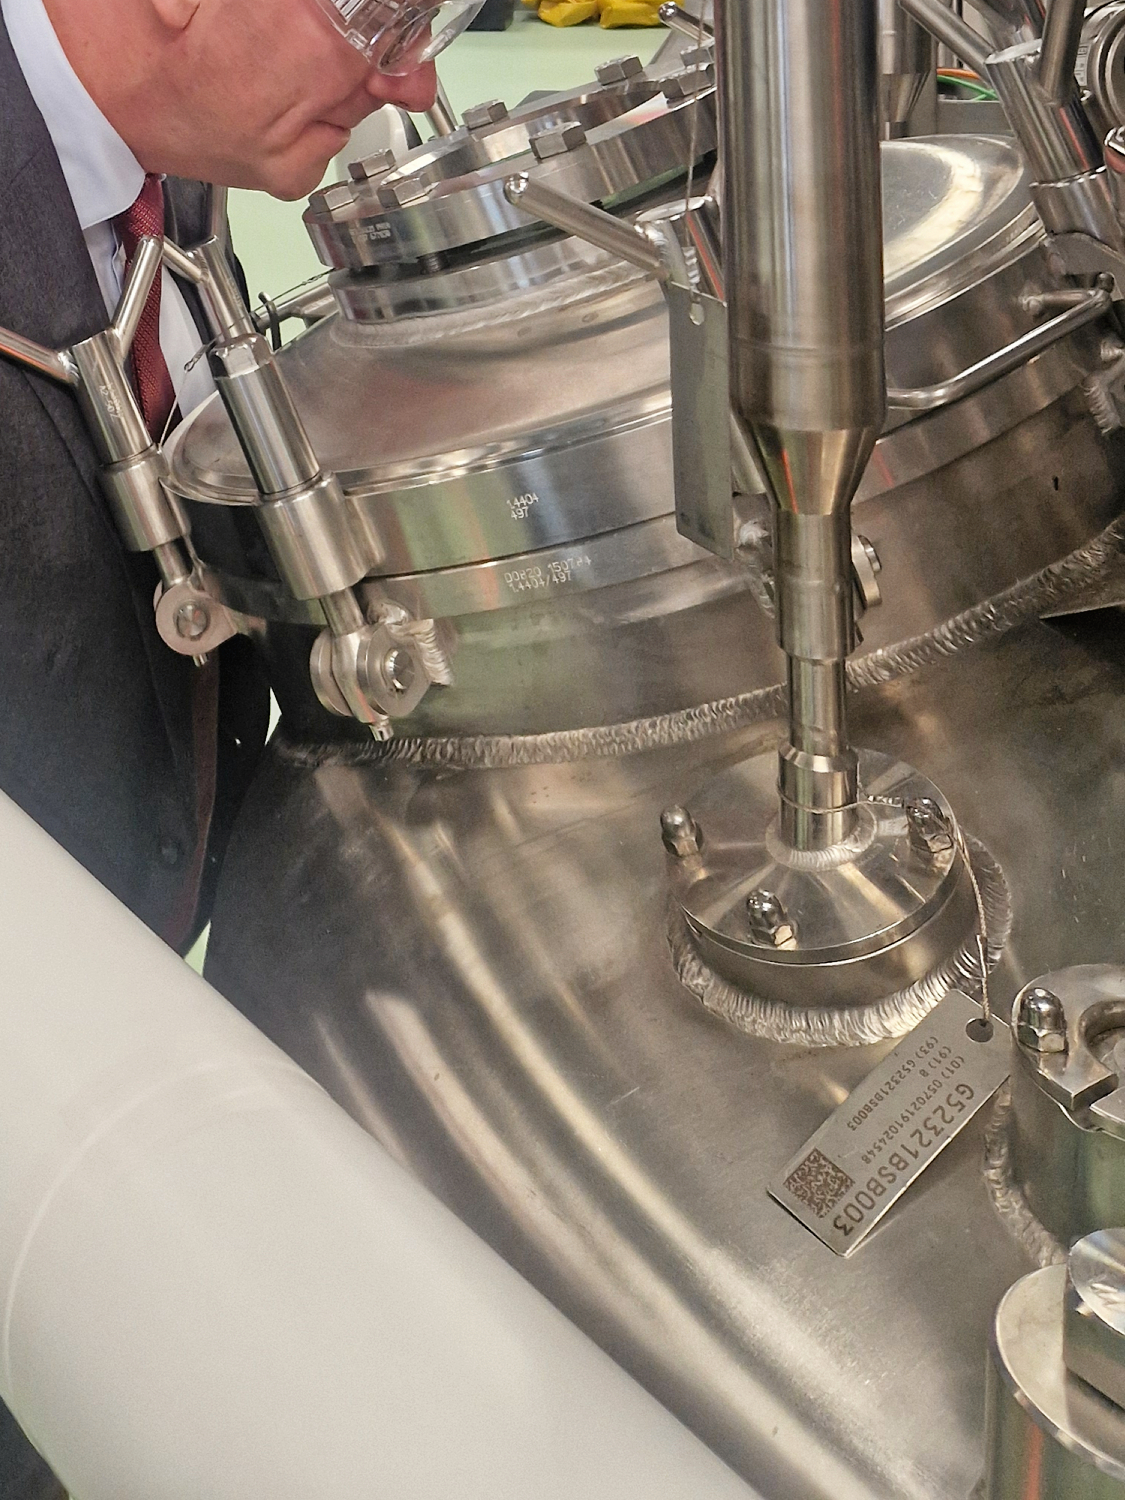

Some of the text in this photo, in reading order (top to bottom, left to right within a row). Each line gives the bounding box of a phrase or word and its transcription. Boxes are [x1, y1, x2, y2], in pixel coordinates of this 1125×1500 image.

[511, 506, 529, 520] 497
[915, 1036, 938, 1059] (93)
[927, 1046, 952, 1069] (91)
[941, 1055, 965, 1079] (01)
[833, 1083, 974, 1236] G52321BSB003
